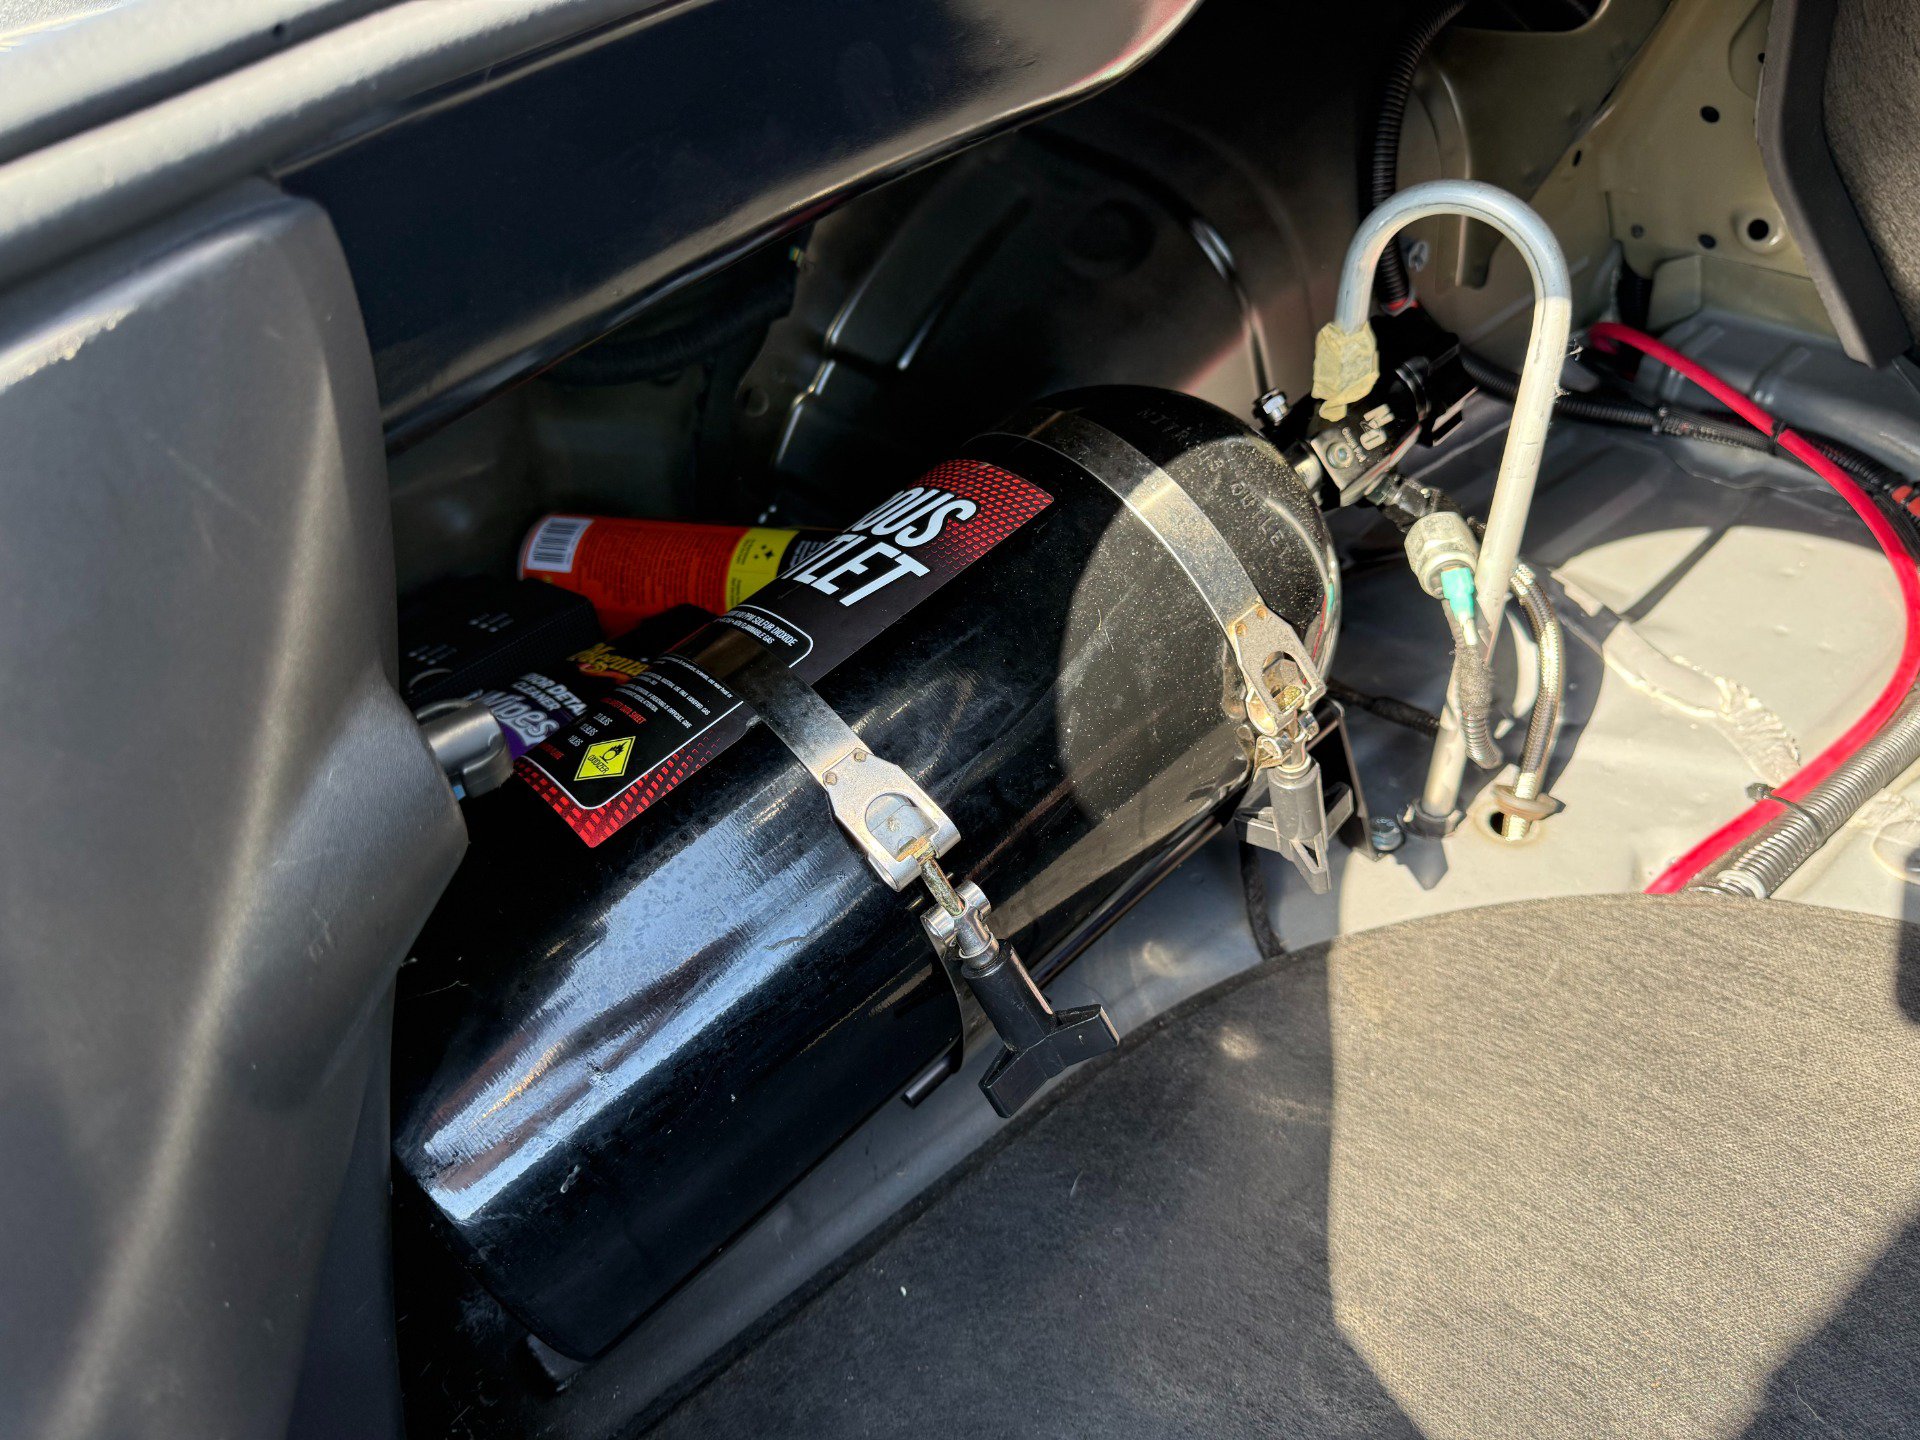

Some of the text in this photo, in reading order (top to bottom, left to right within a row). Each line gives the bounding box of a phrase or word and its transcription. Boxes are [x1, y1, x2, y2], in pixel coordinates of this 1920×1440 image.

[845, 486, 977, 548] OUS
[1230, 480, 1294, 560] OUTLET
[779, 533, 931, 607] TLET
[750, 615, 775, 631] SULFUR
[771, 625, 798, 646] DIOXIDE
[761, 633, 774, 645] GAS
[511, 680, 562, 712] CLEANER
[628, 710, 647, 725] SHEET
[681, 719, 692, 728] GIVE
[700, 707, 711, 716] GAS
[587, 754, 611, 774] OXIDIZER
